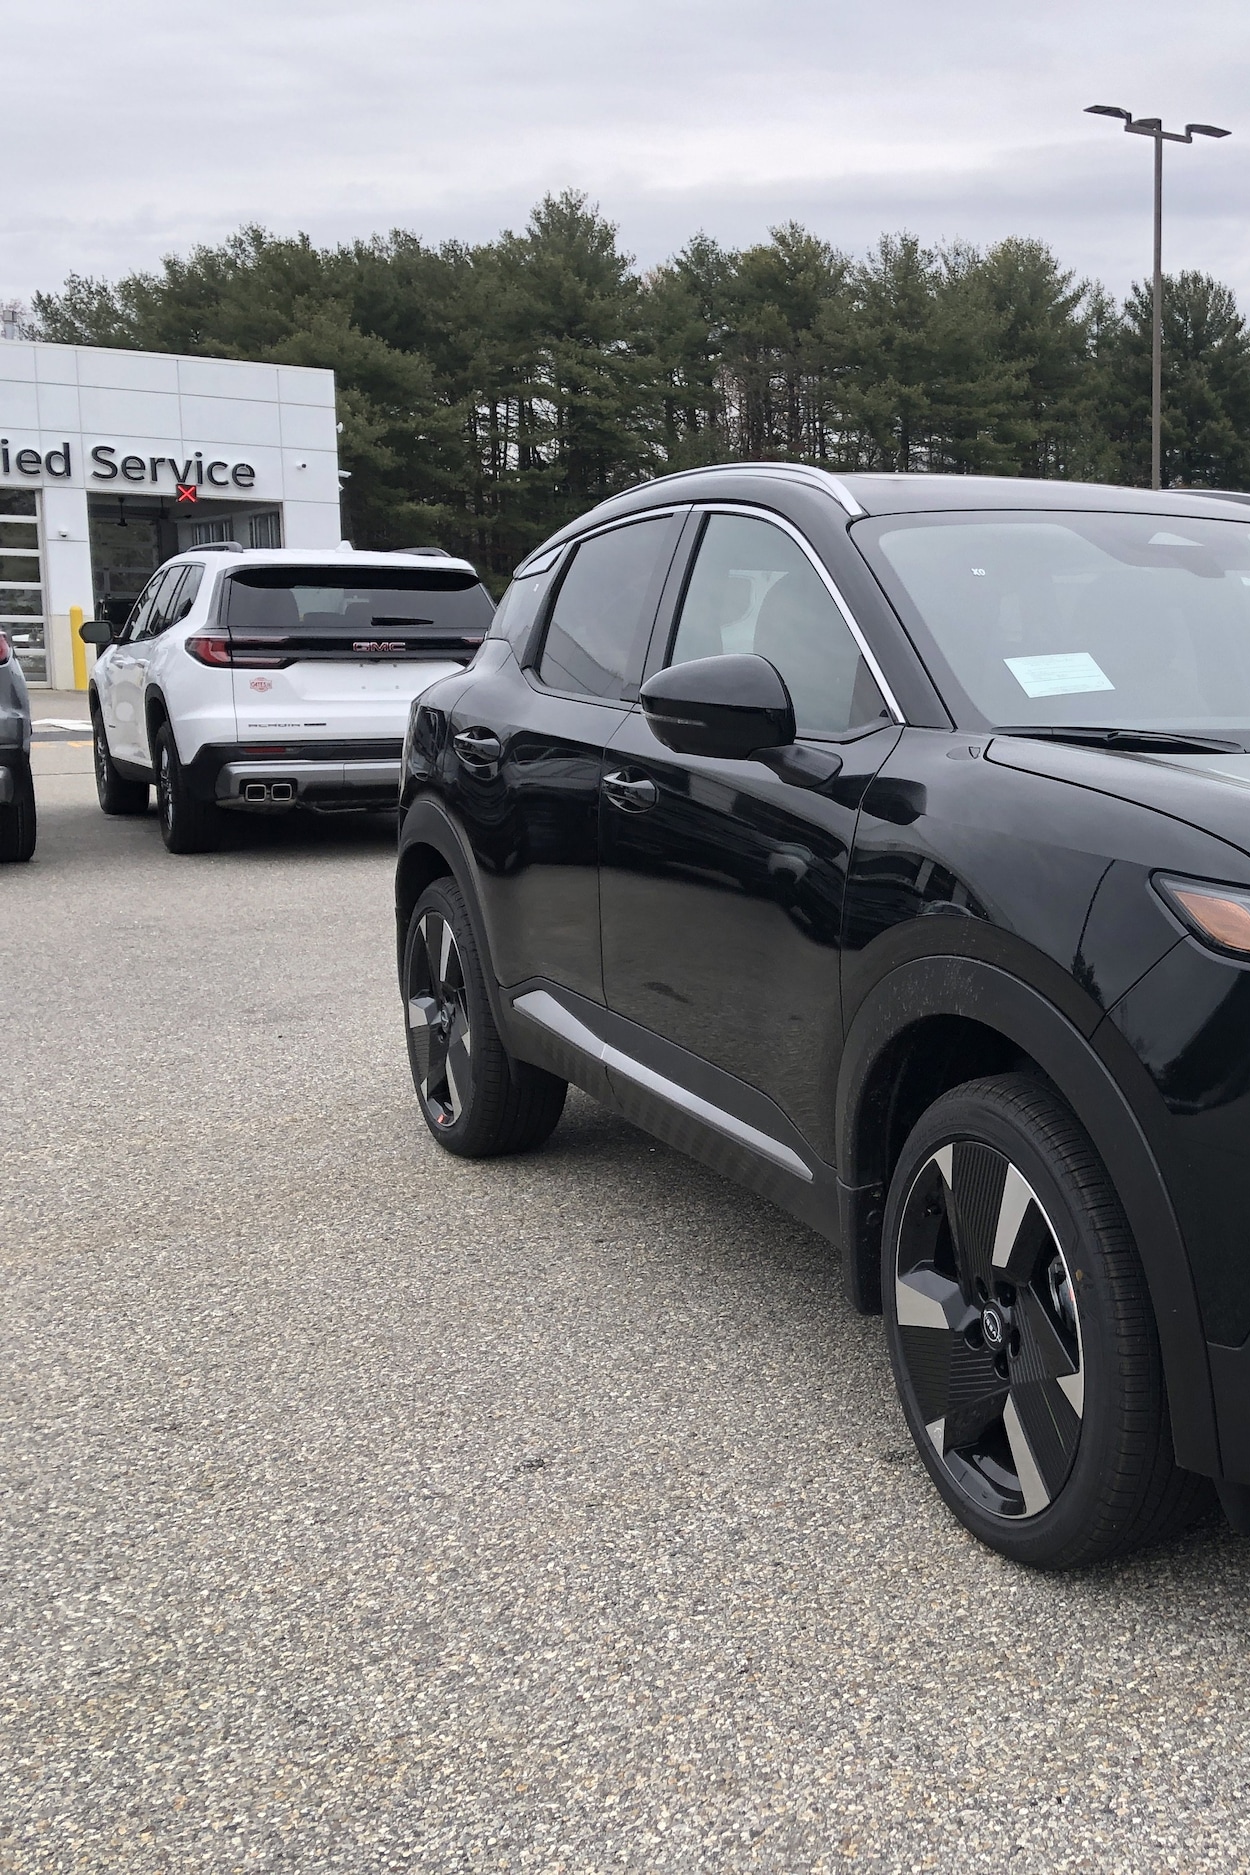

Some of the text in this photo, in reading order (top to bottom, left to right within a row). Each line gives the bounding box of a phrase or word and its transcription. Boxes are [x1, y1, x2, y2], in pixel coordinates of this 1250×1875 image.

[1, 439, 256, 488] ied Service
[353, 642, 406, 651] GMC
